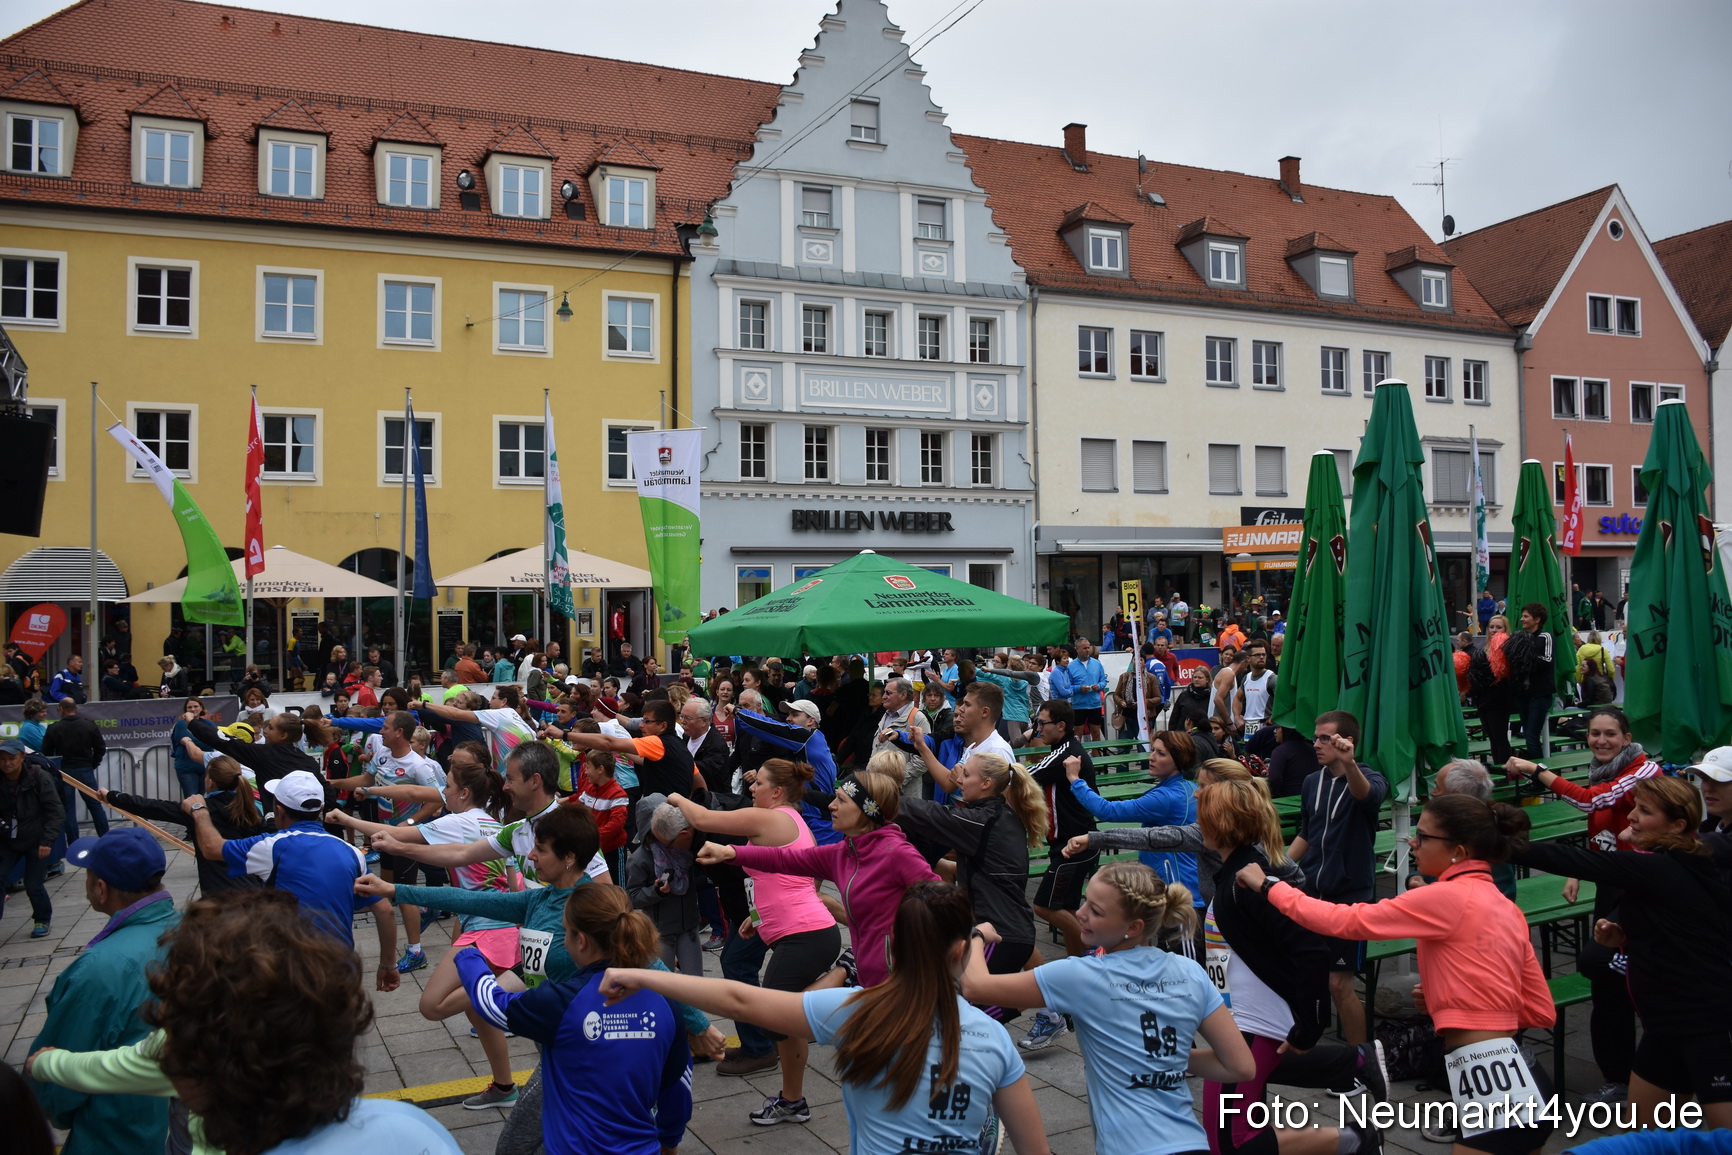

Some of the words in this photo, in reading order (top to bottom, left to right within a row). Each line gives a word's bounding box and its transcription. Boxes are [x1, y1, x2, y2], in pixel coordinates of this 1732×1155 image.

[809, 380, 878, 399] BRILLEN
[881, 383, 942, 403] WEBER
[791, 509, 875, 531] BRILLEN
[878, 510, 955, 532] WEBER
[863, 597, 976, 609] Lammsbräu
[874, 591, 951, 600] Neumarkter
[1127, 592, 1138, 613] B
[30, 623, 47, 631] DKMS
[120, 714, 177, 727] INDUSTRY
[1447, 1056, 1469, 1070] PARTL
[1469, 1047, 1510, 1062] Neumarkt
[1458, 1058, 1527, 1100] 4001
